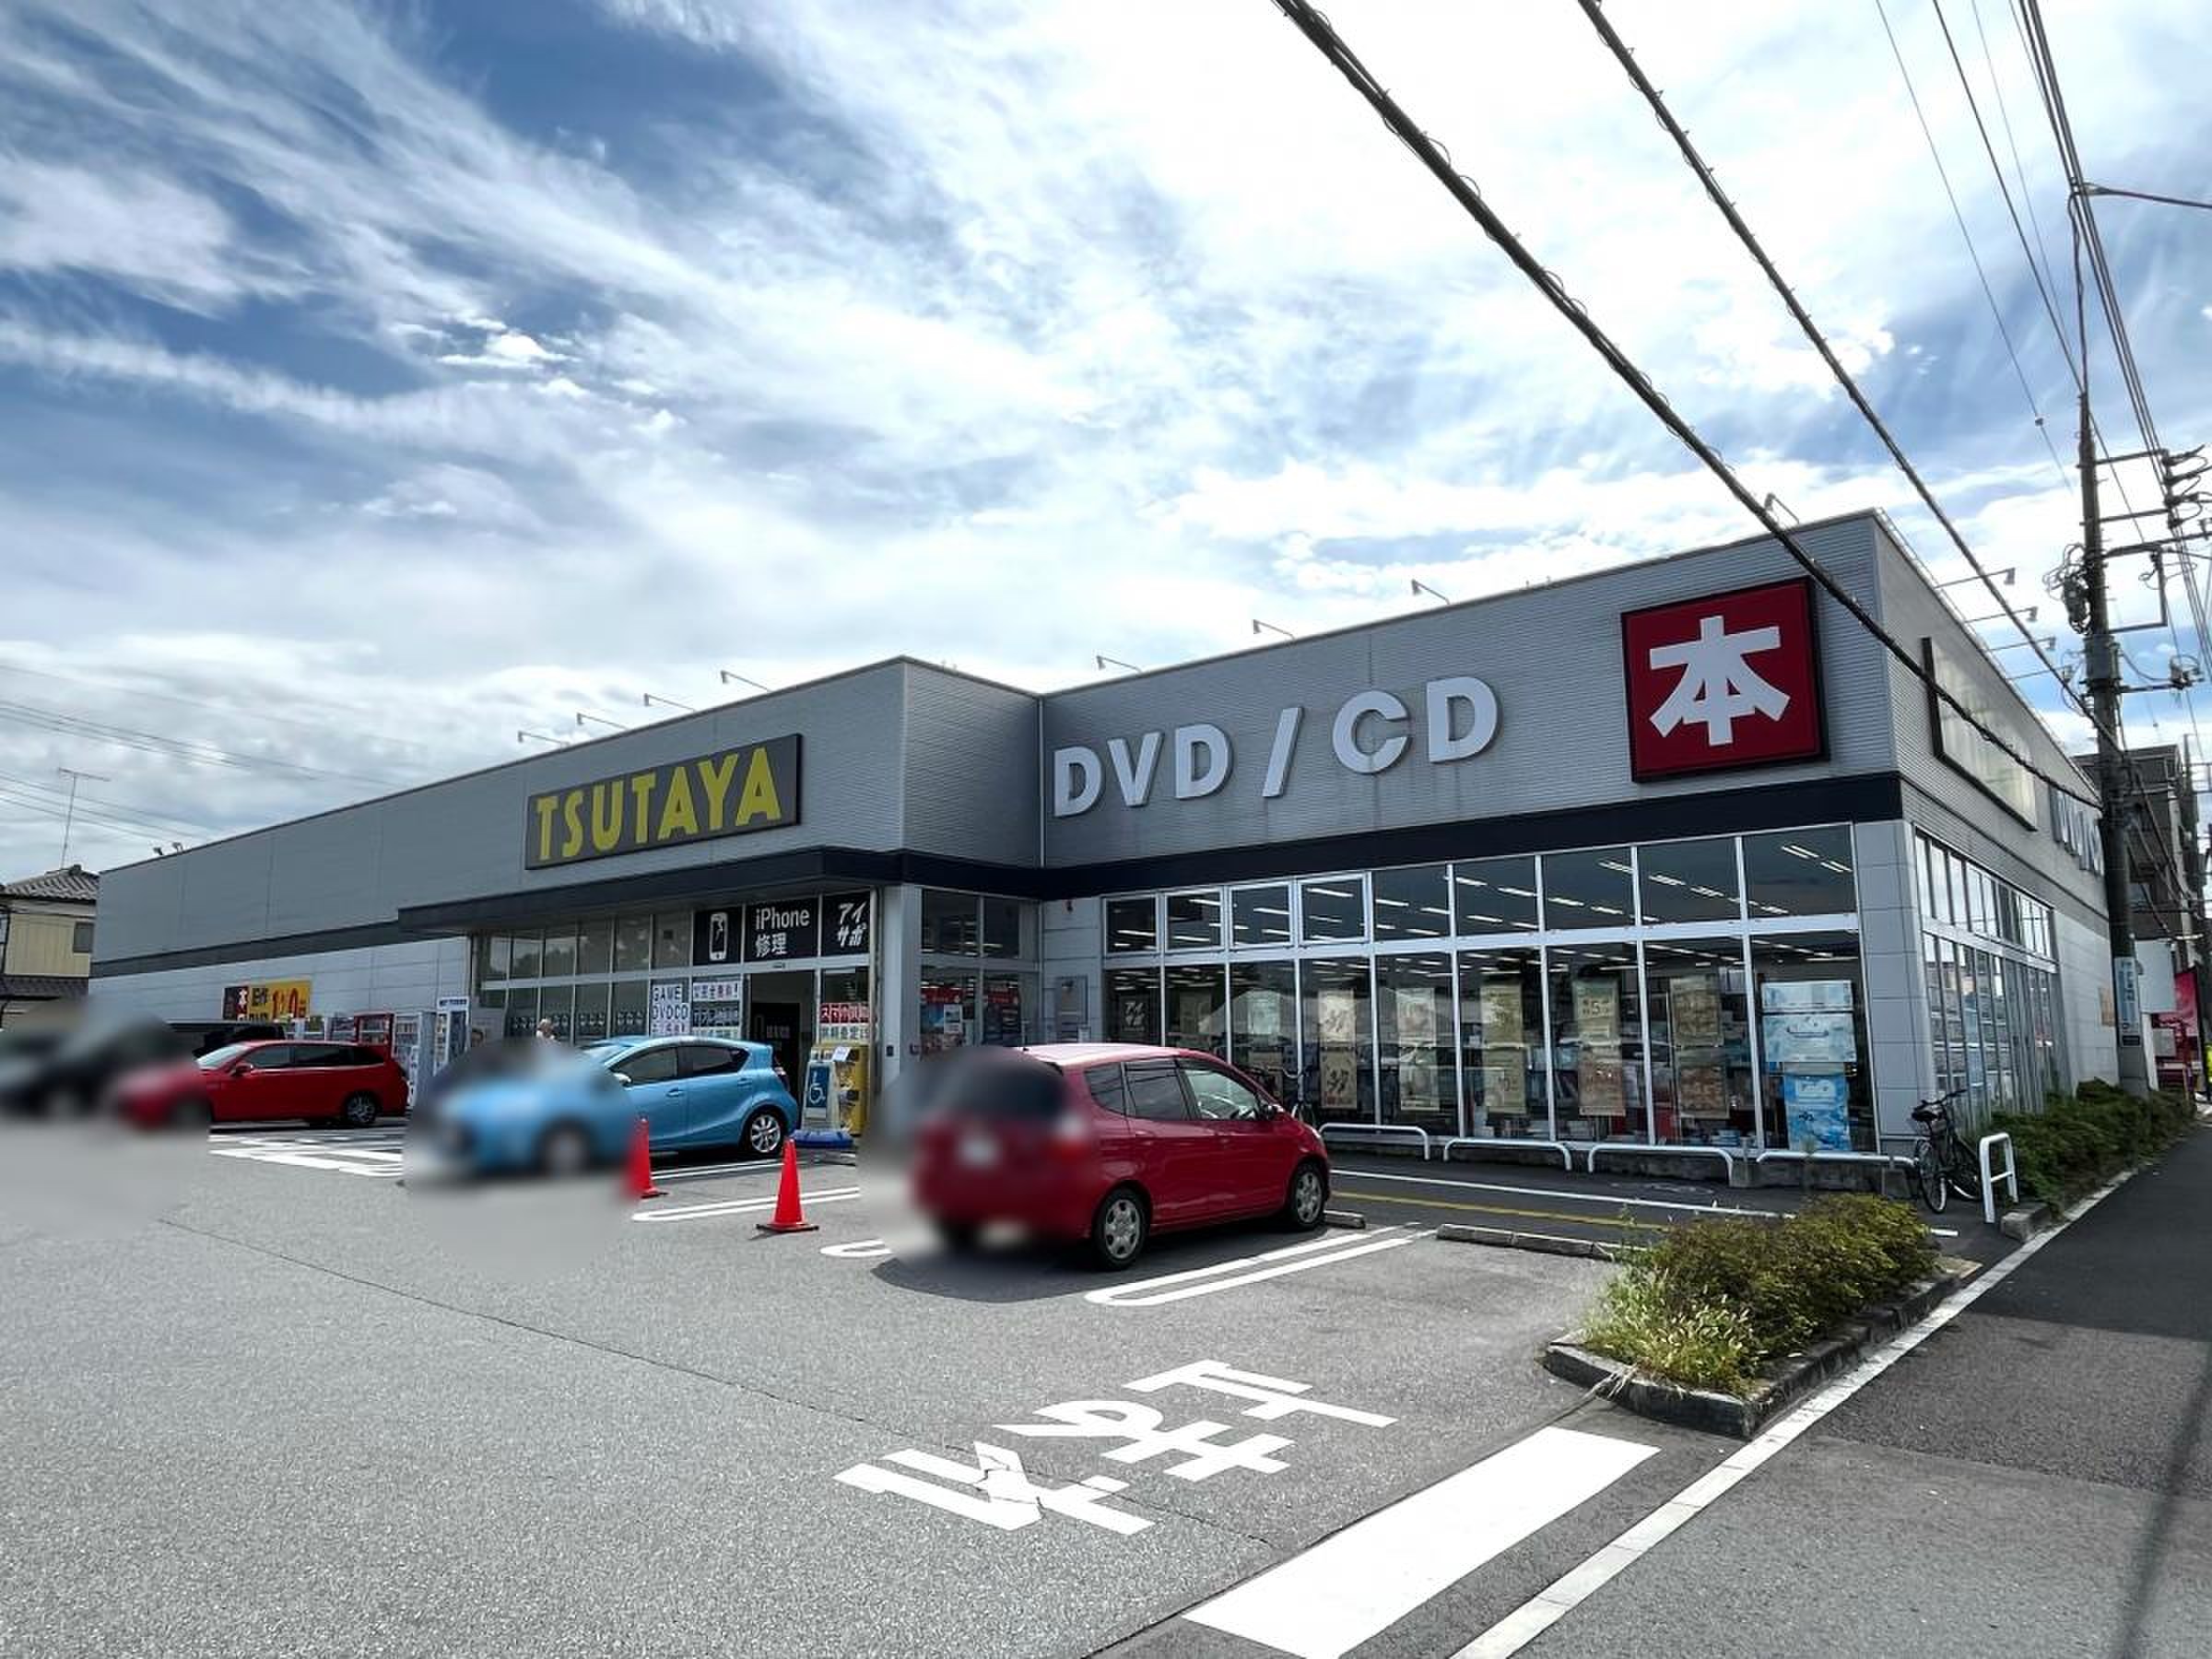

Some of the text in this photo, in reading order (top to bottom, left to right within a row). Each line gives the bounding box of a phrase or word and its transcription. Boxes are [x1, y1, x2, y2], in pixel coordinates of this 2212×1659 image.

[1648, 615, 1791, 747] 本
[1053, 723, 1232, 818] DVD
[1331, 676, 1502, 775] CD
[535, 747, 782, 862] TSUTAYA
[755, 932, 788, 958] 修理
[756, 906, 811, 930] iPhone
[837, 923, 867, 947] サポ
[838, 901, 867, 924] アイ
[832, 1359, 1399, 1535] 止まれ
